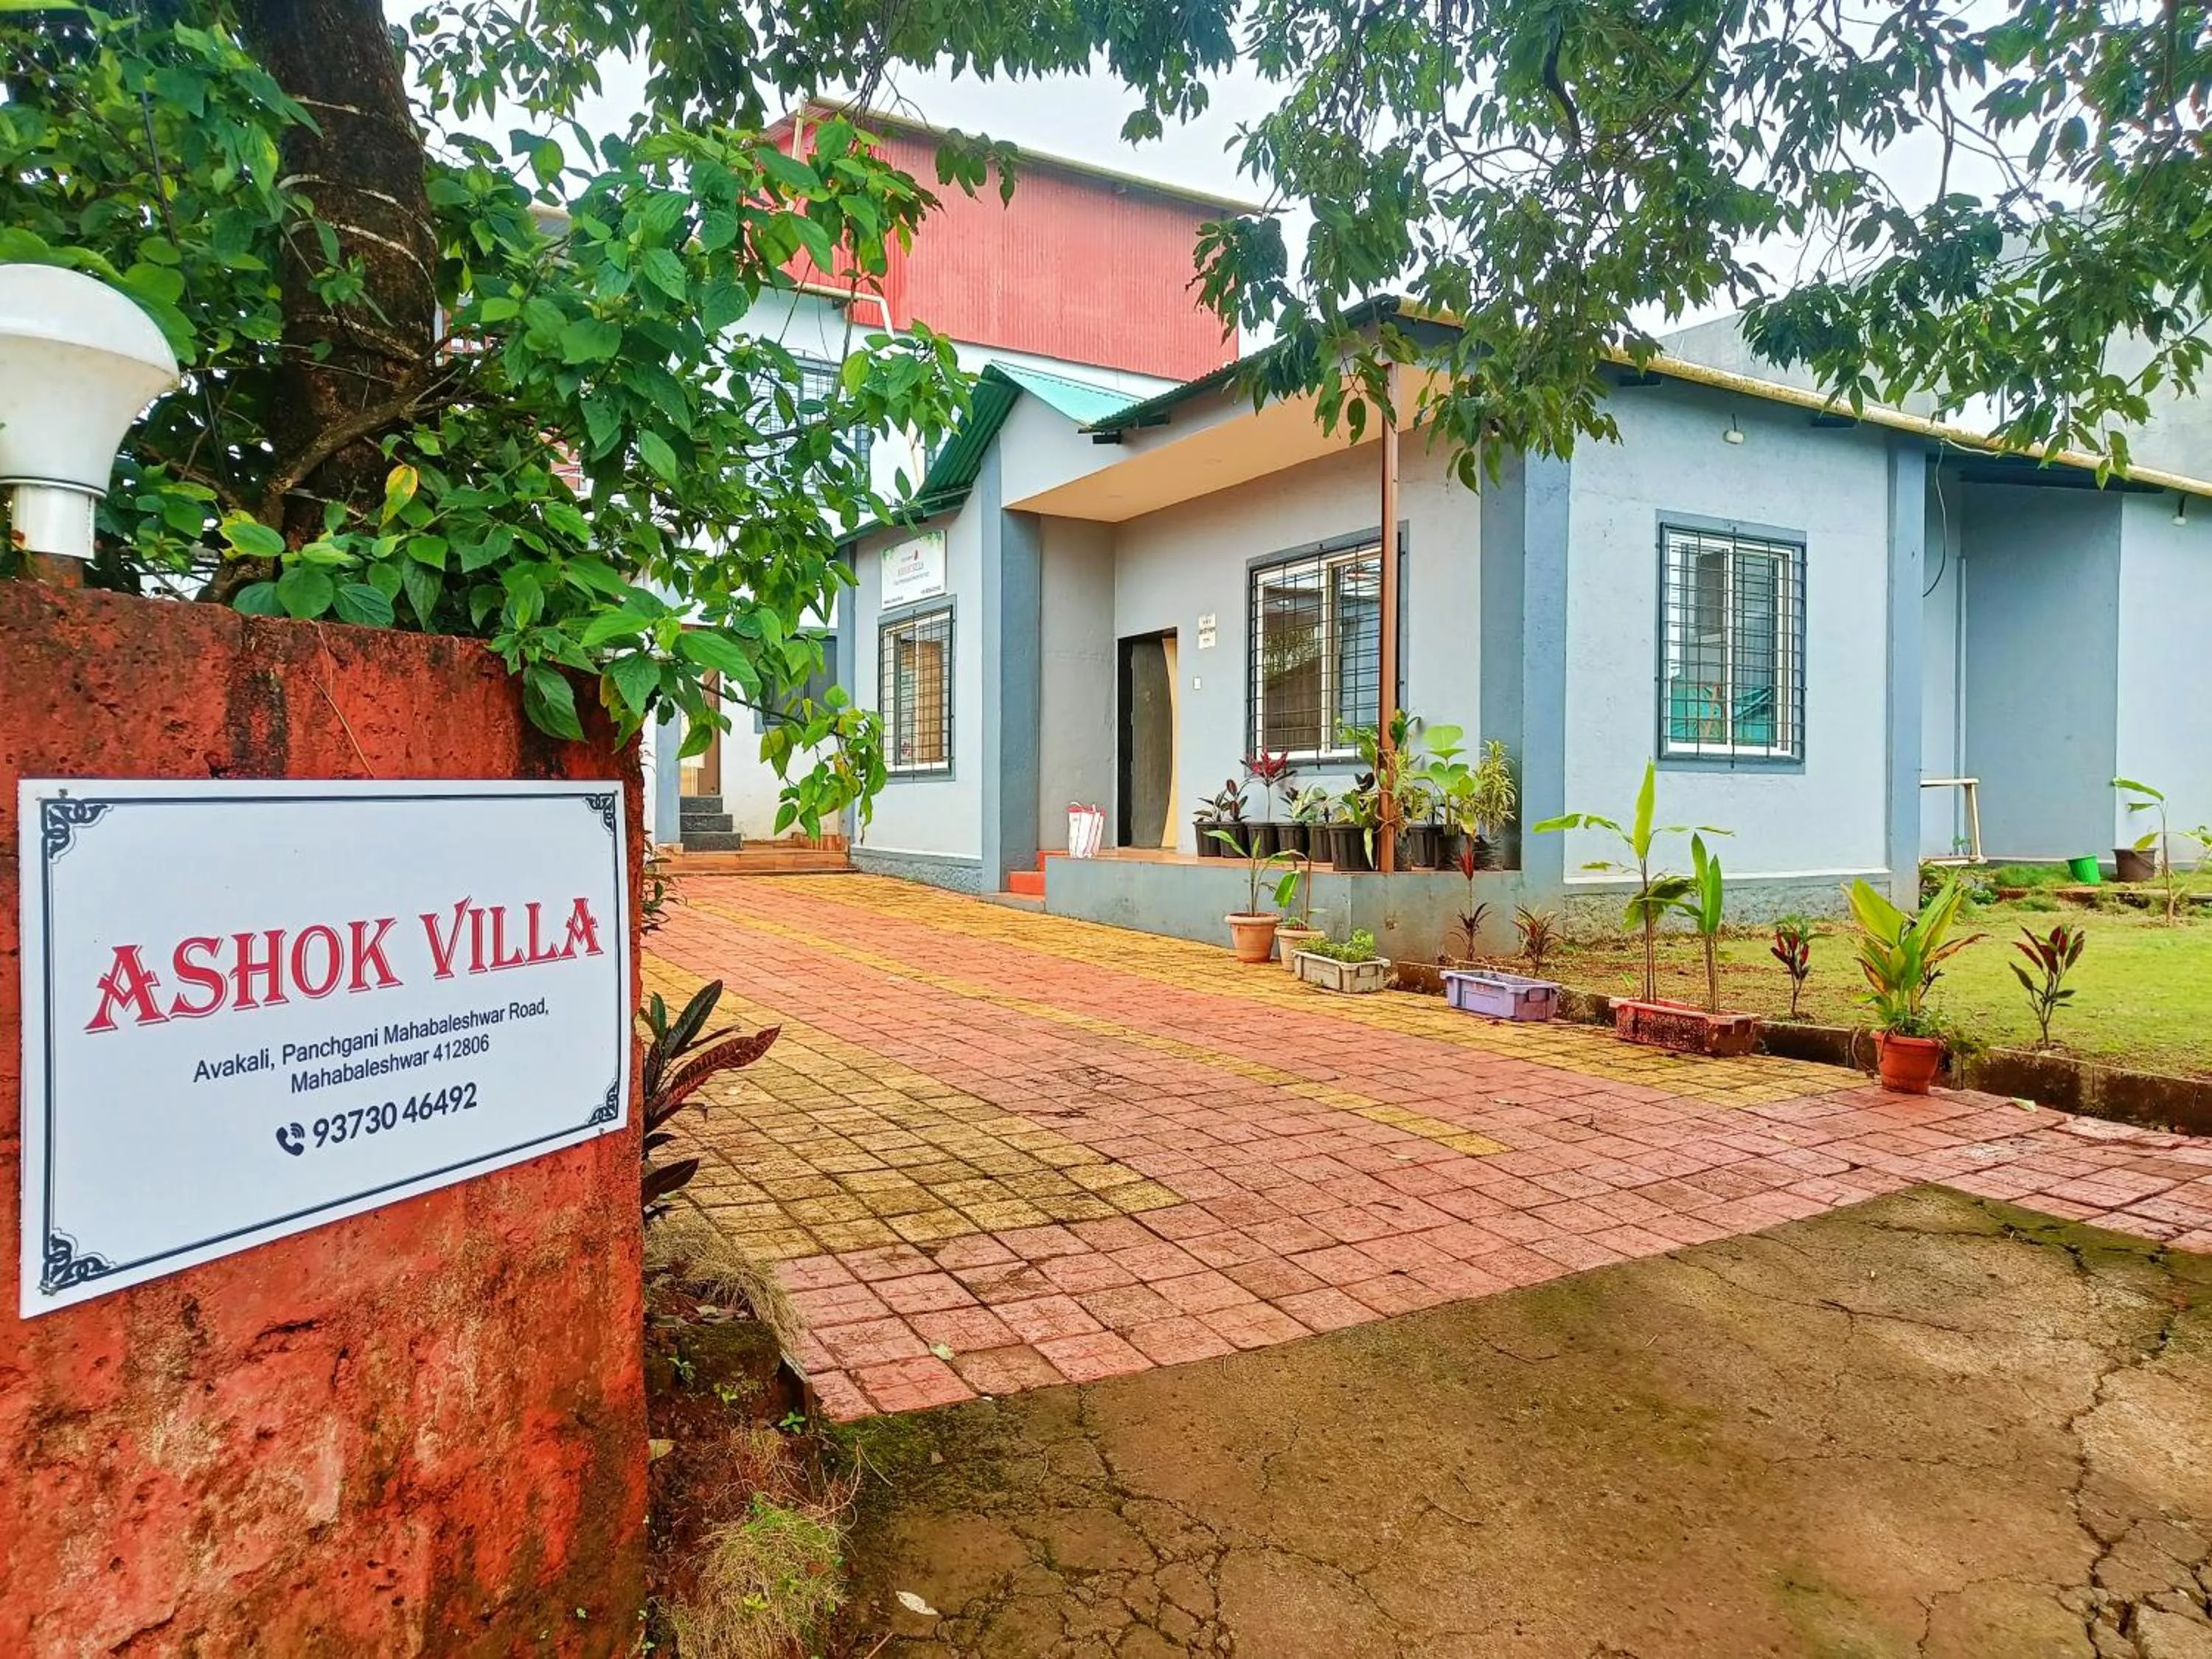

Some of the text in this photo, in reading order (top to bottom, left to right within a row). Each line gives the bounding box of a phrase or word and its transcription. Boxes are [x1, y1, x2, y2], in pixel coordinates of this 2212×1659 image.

[83, 896, 604, 1034] ASHOK VILLA
[192, 997, 549, 1083] Avakali, Panchgani Mahabaleshwar Road,
[291, 1034, 490, 1094] Mahabaleshwar 412806
[312, 1082, 477, 1149] 93730 46492
